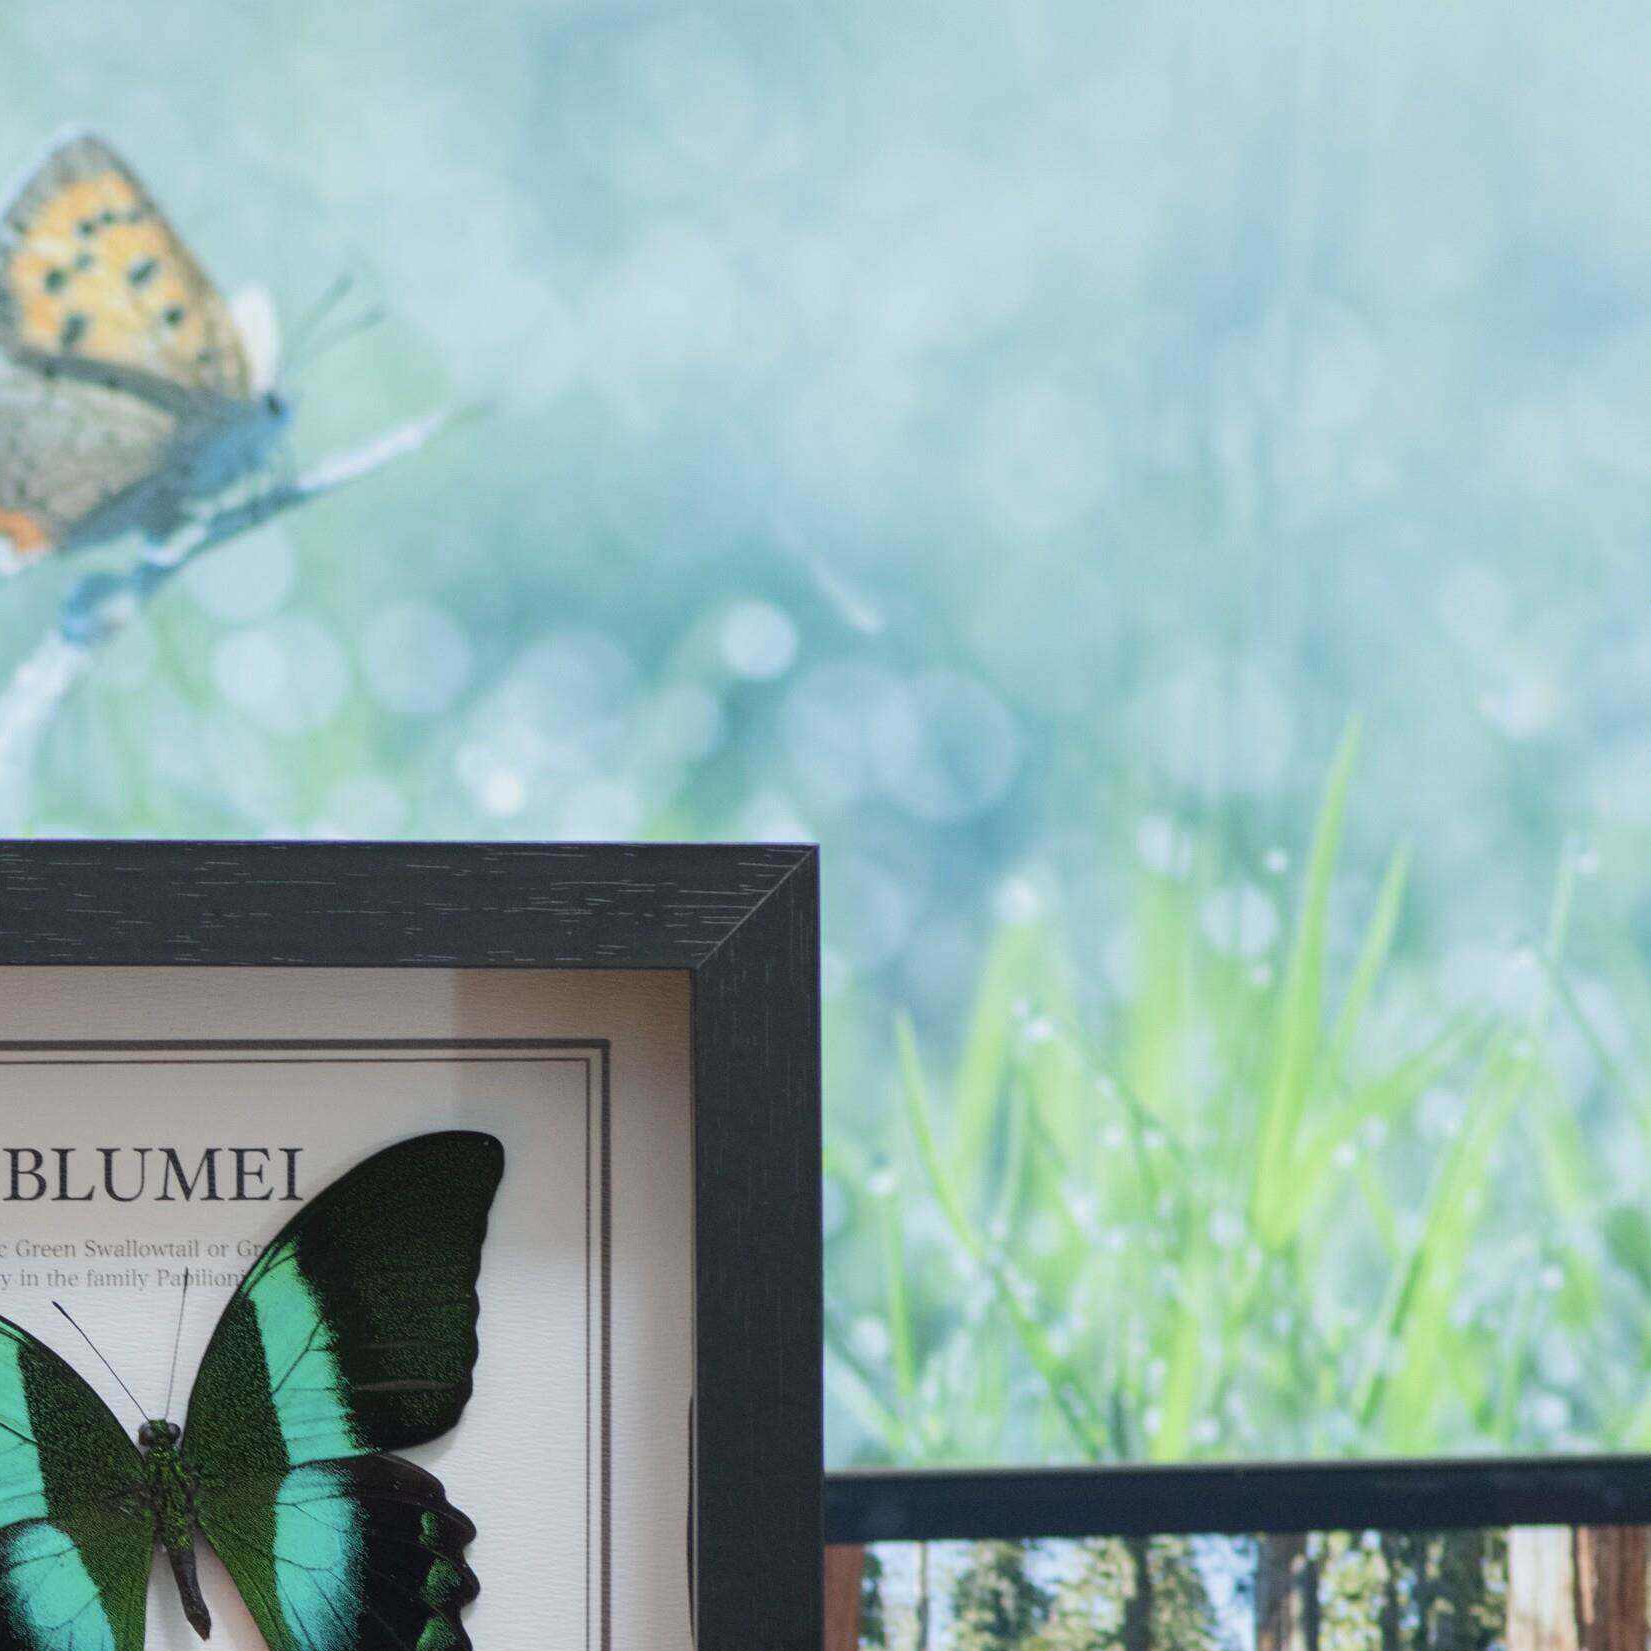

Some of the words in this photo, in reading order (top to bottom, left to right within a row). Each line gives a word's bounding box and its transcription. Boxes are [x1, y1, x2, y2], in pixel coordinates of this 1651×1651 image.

[2, 1147, 305, 1202] BLUMEI
[15, 1239, 76, 1258] Green
[85, 1239, 199, 1258] Swallowtail
[207, 1245, 229, 1258] or
[20, 1268, 39, 1287] in
[47, 1268, 78, 1287] the
[87, 1268, 148, 1291] family
